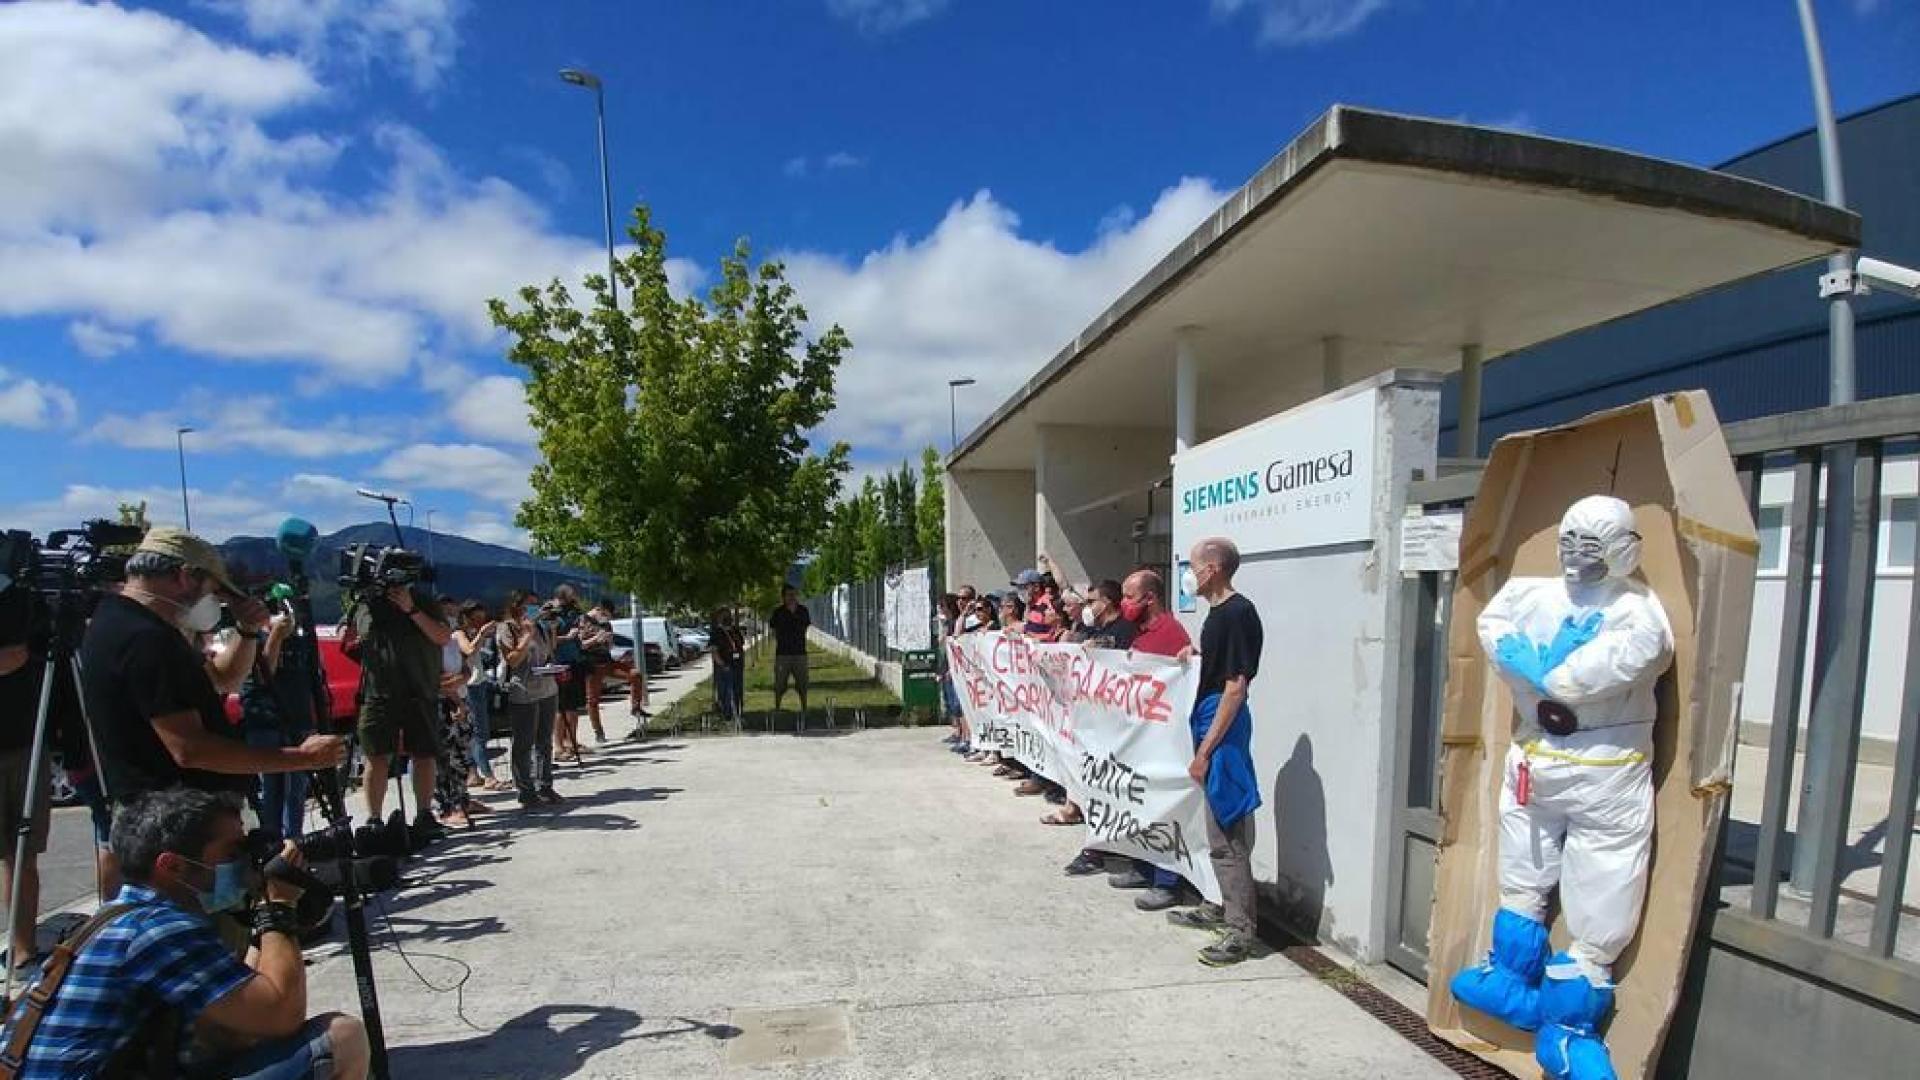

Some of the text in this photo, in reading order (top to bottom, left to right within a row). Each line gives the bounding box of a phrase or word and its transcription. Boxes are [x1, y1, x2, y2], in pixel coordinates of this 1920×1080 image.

[1183, 450, 1353, 514] SIEMENS Gamesa
[1296, 492, 1352, 511] ENERGY
